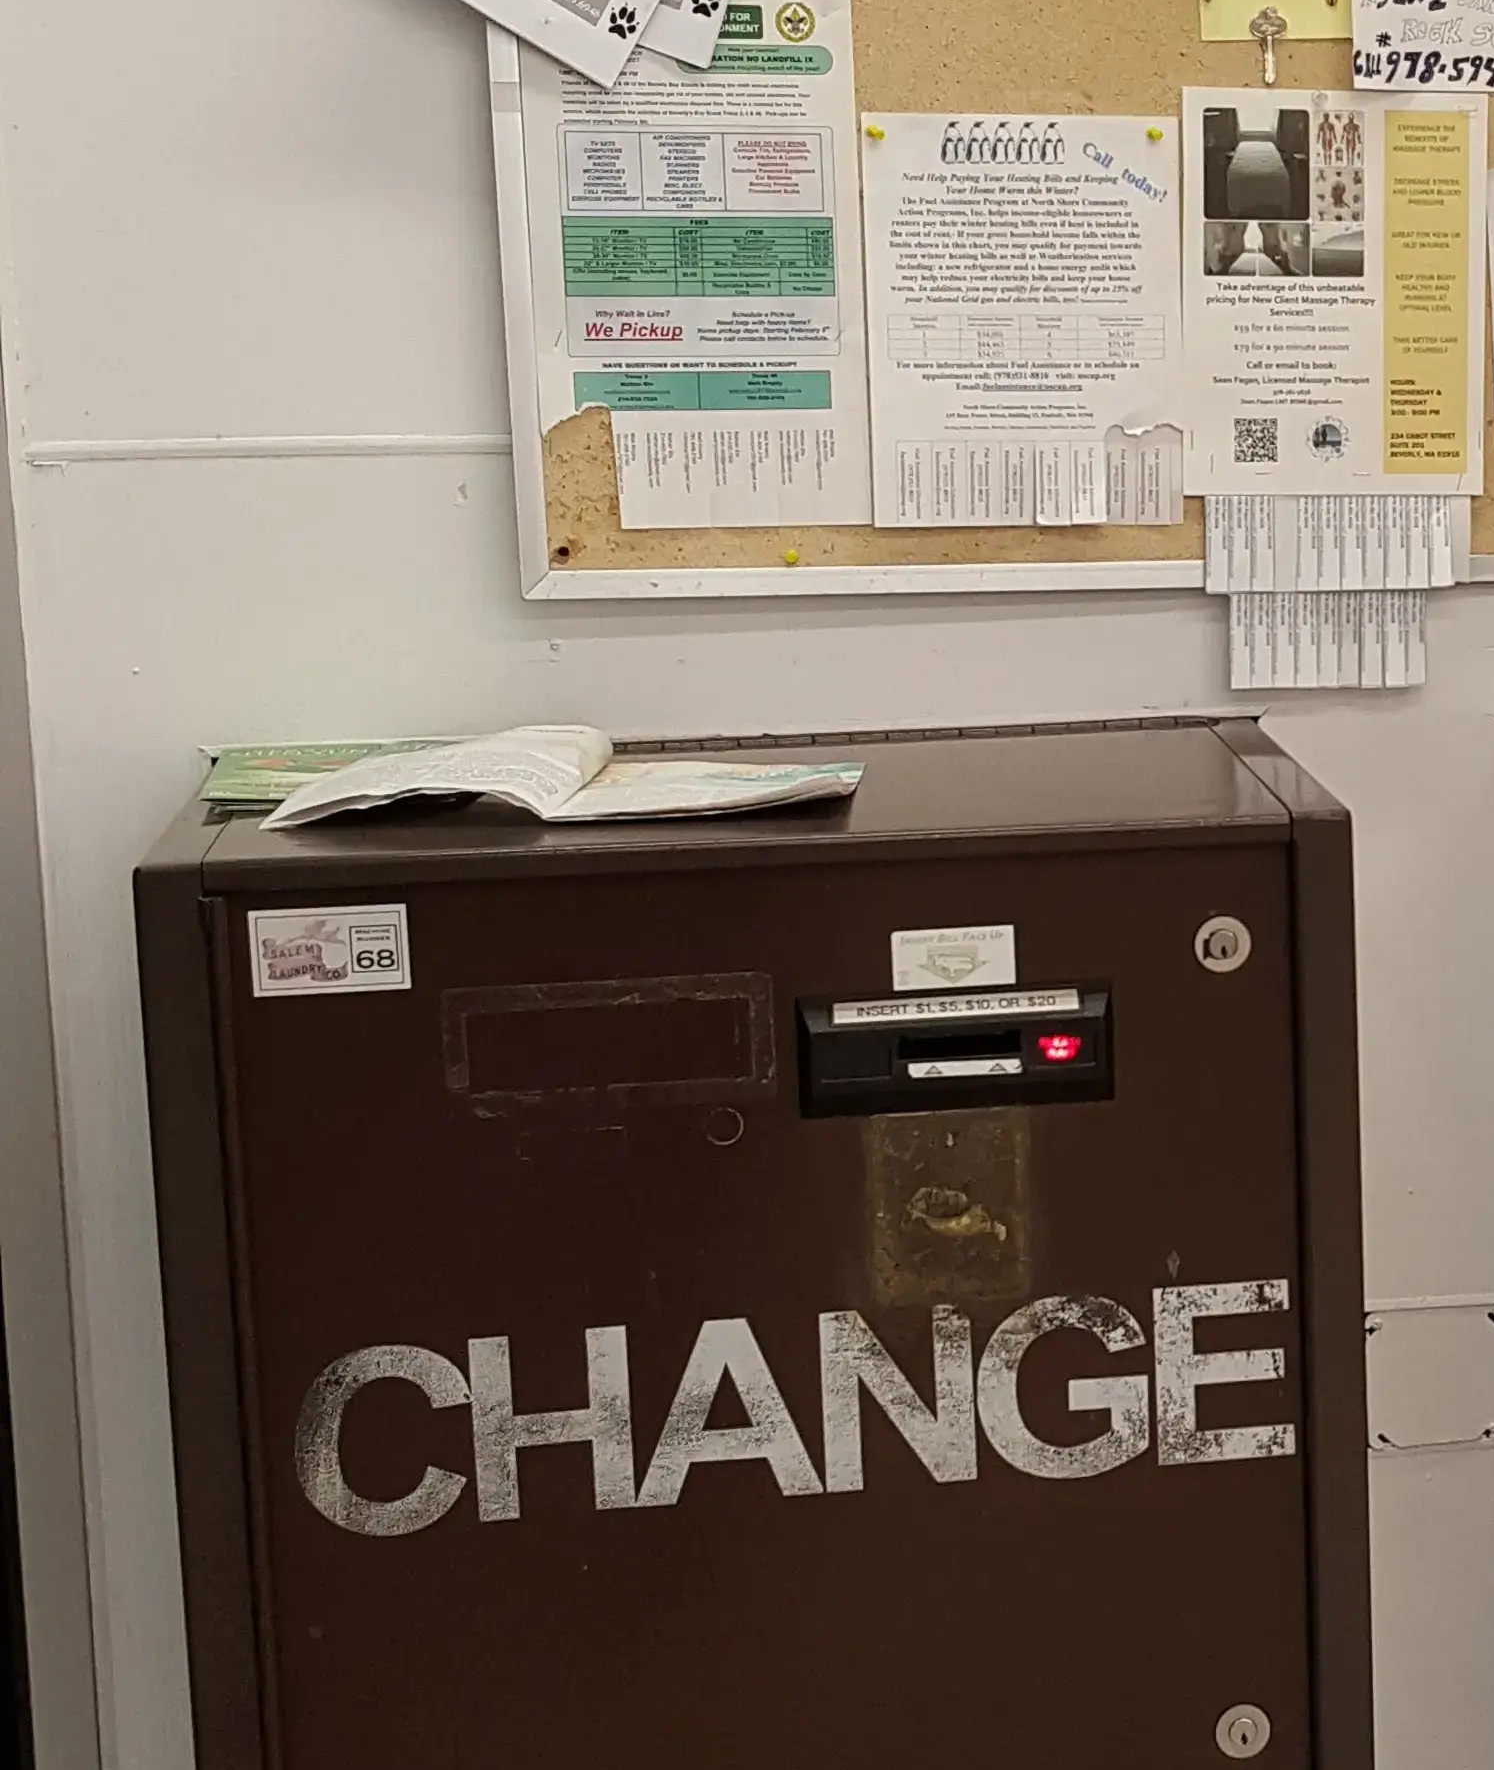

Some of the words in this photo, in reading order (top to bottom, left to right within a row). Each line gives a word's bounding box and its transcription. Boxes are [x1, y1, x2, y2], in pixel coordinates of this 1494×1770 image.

[730, 12, 750, 21] FOR
[1082, 142, 1114, 170] Call
[1121, 168, 1168, 203] today!
[583, 322, 617, 339] We
[620, 320, 683, 341] Pickup
[1245, 359, 1263, 370] Call
[1263, 362, 1274, 370] or
[1274, 360, 1300, 370] email
[1300, 361, 1311, 370] to
[1311, 360, 1337, 370] book:
[270, 944, 314, 959] SALEM
[357, 949, 395, 968] 68
[276, 966, 322, 978] LAUNDRY
[856, 1005, 907, 1017] INSERT
[998, 997, 1019, 1009] OR
[1027, 995, 1056, 1007] $20
[294, 1278, 1295, 1537] CHANGE
